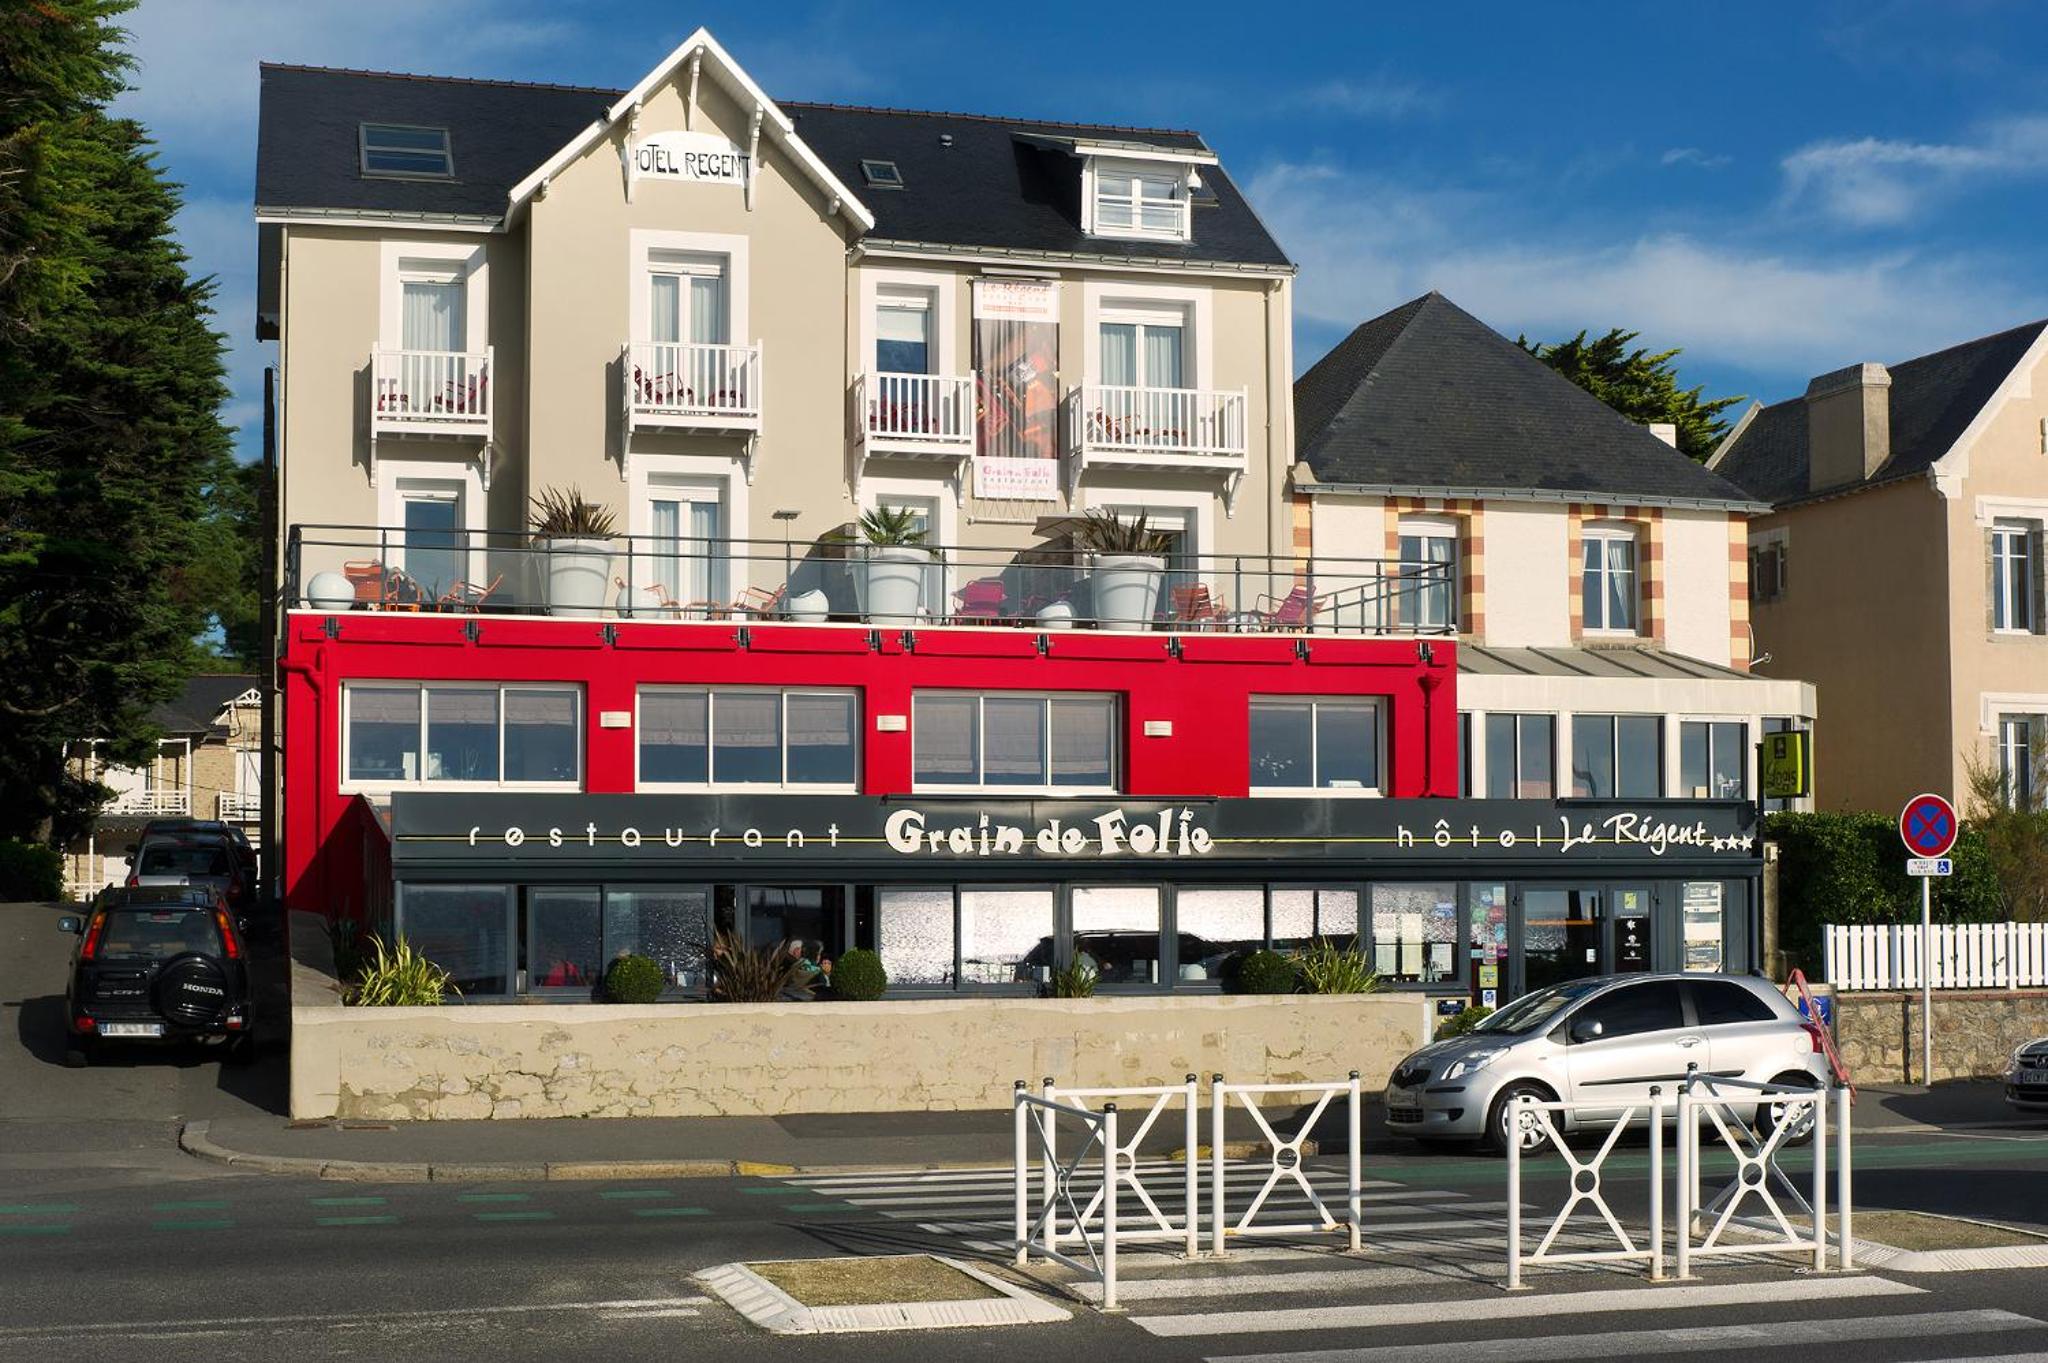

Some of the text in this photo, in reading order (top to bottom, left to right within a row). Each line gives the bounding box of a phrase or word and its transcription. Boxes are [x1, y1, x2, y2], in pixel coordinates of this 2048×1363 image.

[684, 152, 750, 179] REGENT
[469, 822, 839, 847] restaurant
[884, 805, 1215, 856] Grain de Folie
[1397, 818, 1541, 848] hôtel
[1559, 812, 1706, 856] Le Régent
[182, 982, 224, 996] HONDA
